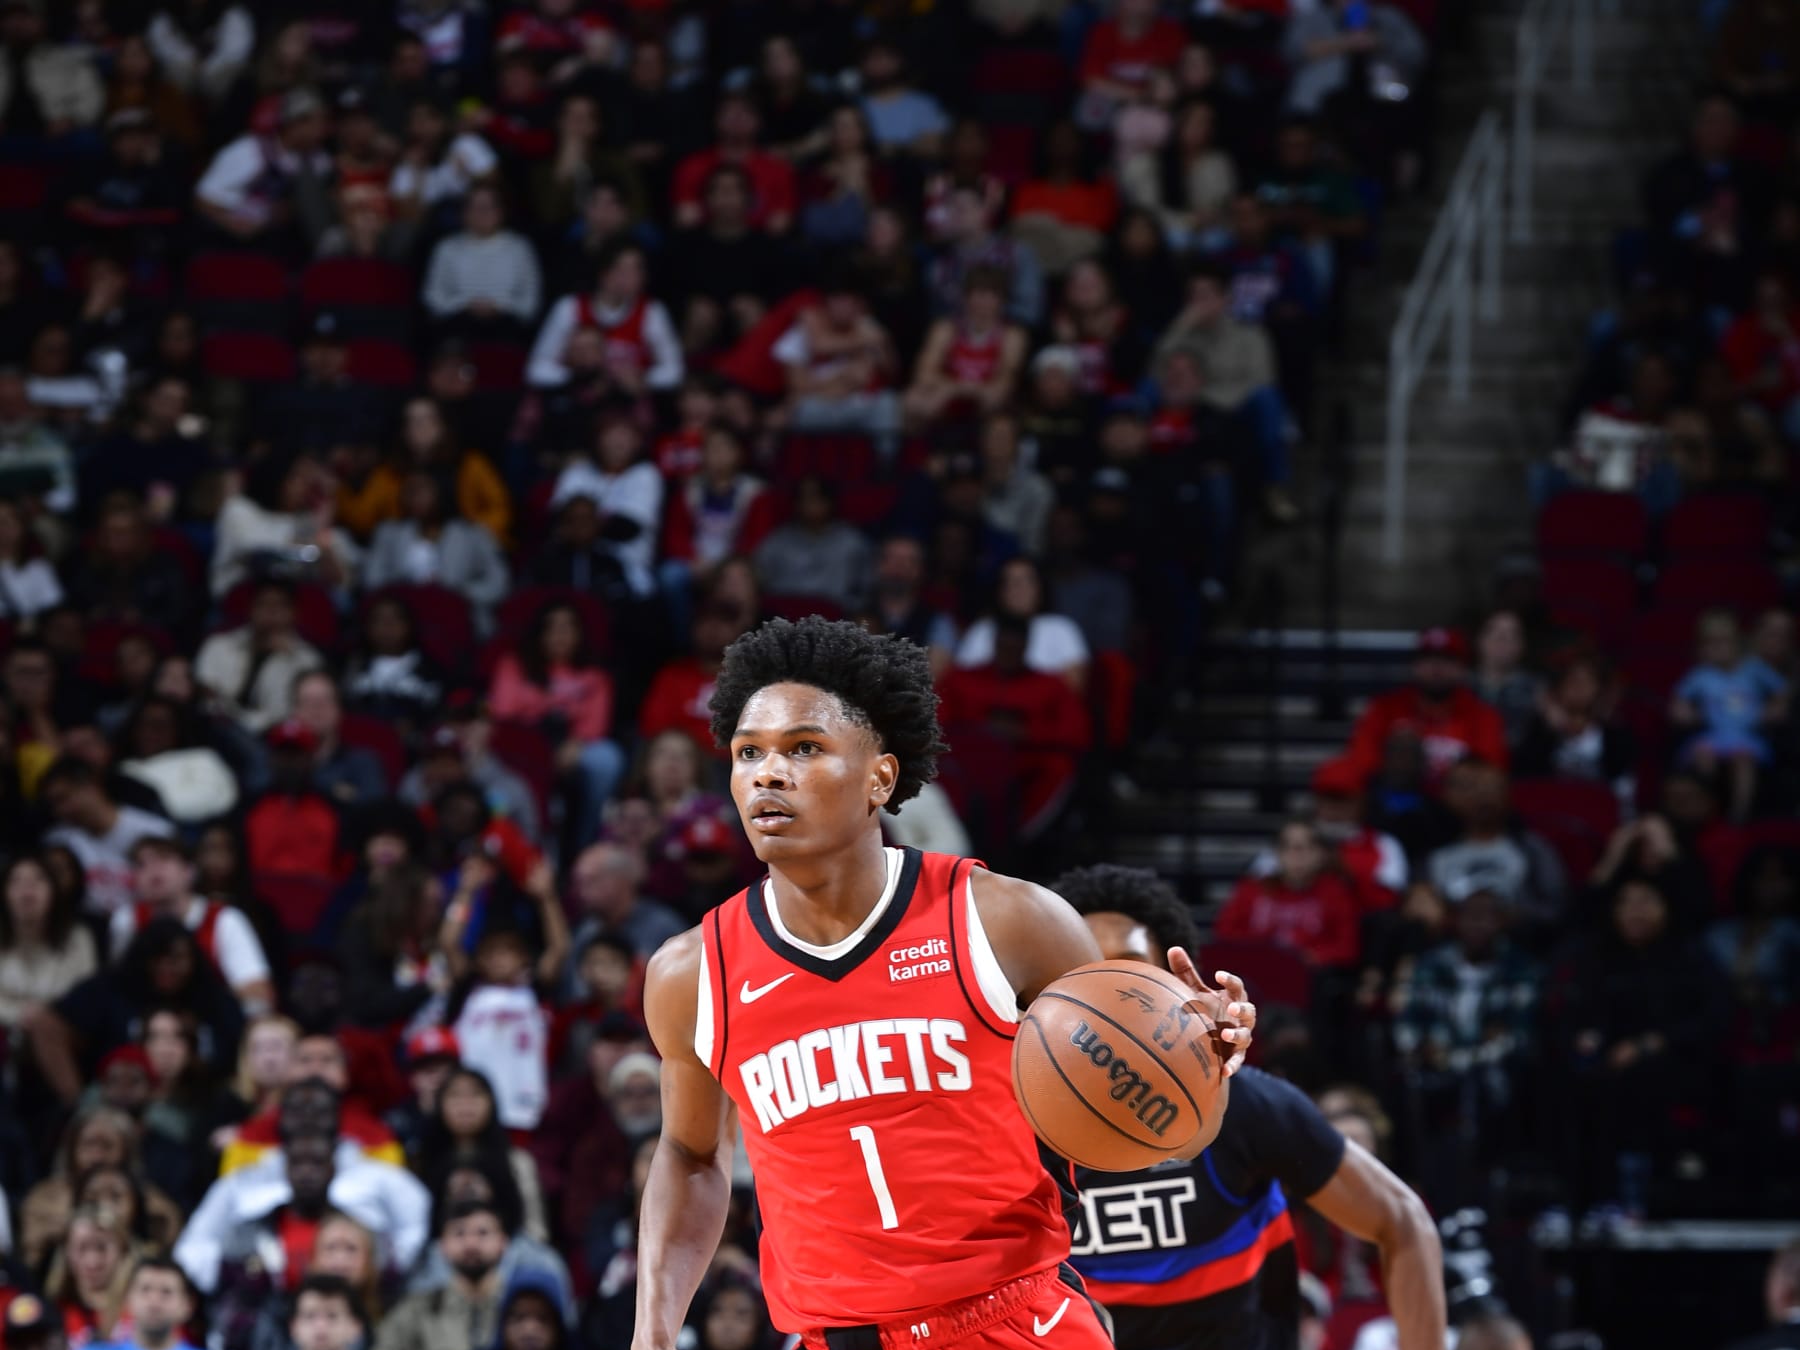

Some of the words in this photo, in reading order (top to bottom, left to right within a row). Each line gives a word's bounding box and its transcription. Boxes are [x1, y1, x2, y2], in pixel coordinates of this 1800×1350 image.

[888, 959, 951, 982] karma
[889, 938, 949, 963] credit
[738, 1018, 973, 1134] ROCKETS
[1068, 1019, 1180, 1138] Wilson
[849, 1125, 899, 1230] 1
